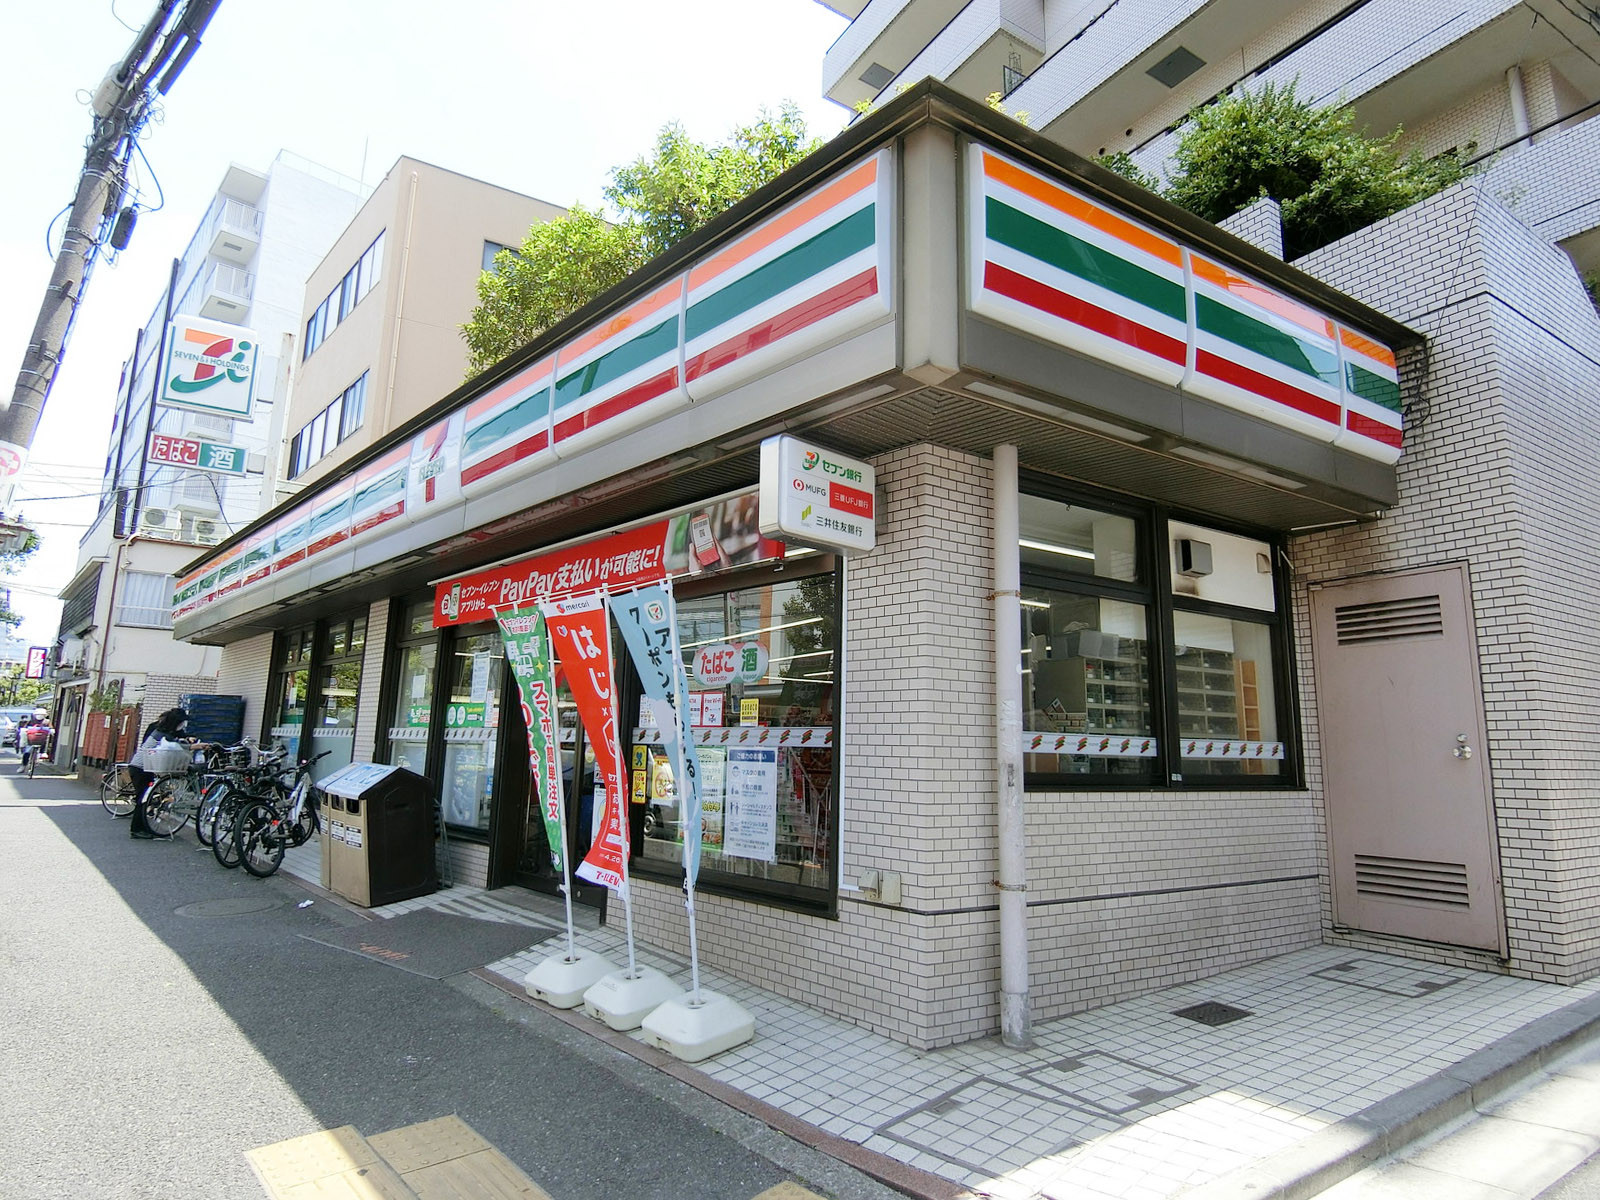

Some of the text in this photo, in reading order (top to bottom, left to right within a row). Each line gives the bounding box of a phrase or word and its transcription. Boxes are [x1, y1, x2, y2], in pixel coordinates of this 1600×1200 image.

[209, 357, 250, 372] HOLDINGS
[153, 437, 197, 463] たばこ
[207, 446, 236, 470] 酒
[822, 459, 862, 483] セブン銀行
[805, 485, 827, 497] MUFG
[834, 492, 869, 510] 三菱UFJ銀行
[816, 515, 863, 537] 三井住友銀行
[460, 599, 486, 614] アプリから
[565, 600, 590, 611] mercari
[700, 650, 735, 675] たばこ
[741, 647, 759, 672] 酒
[706, 675, 728, 684] cigarette
